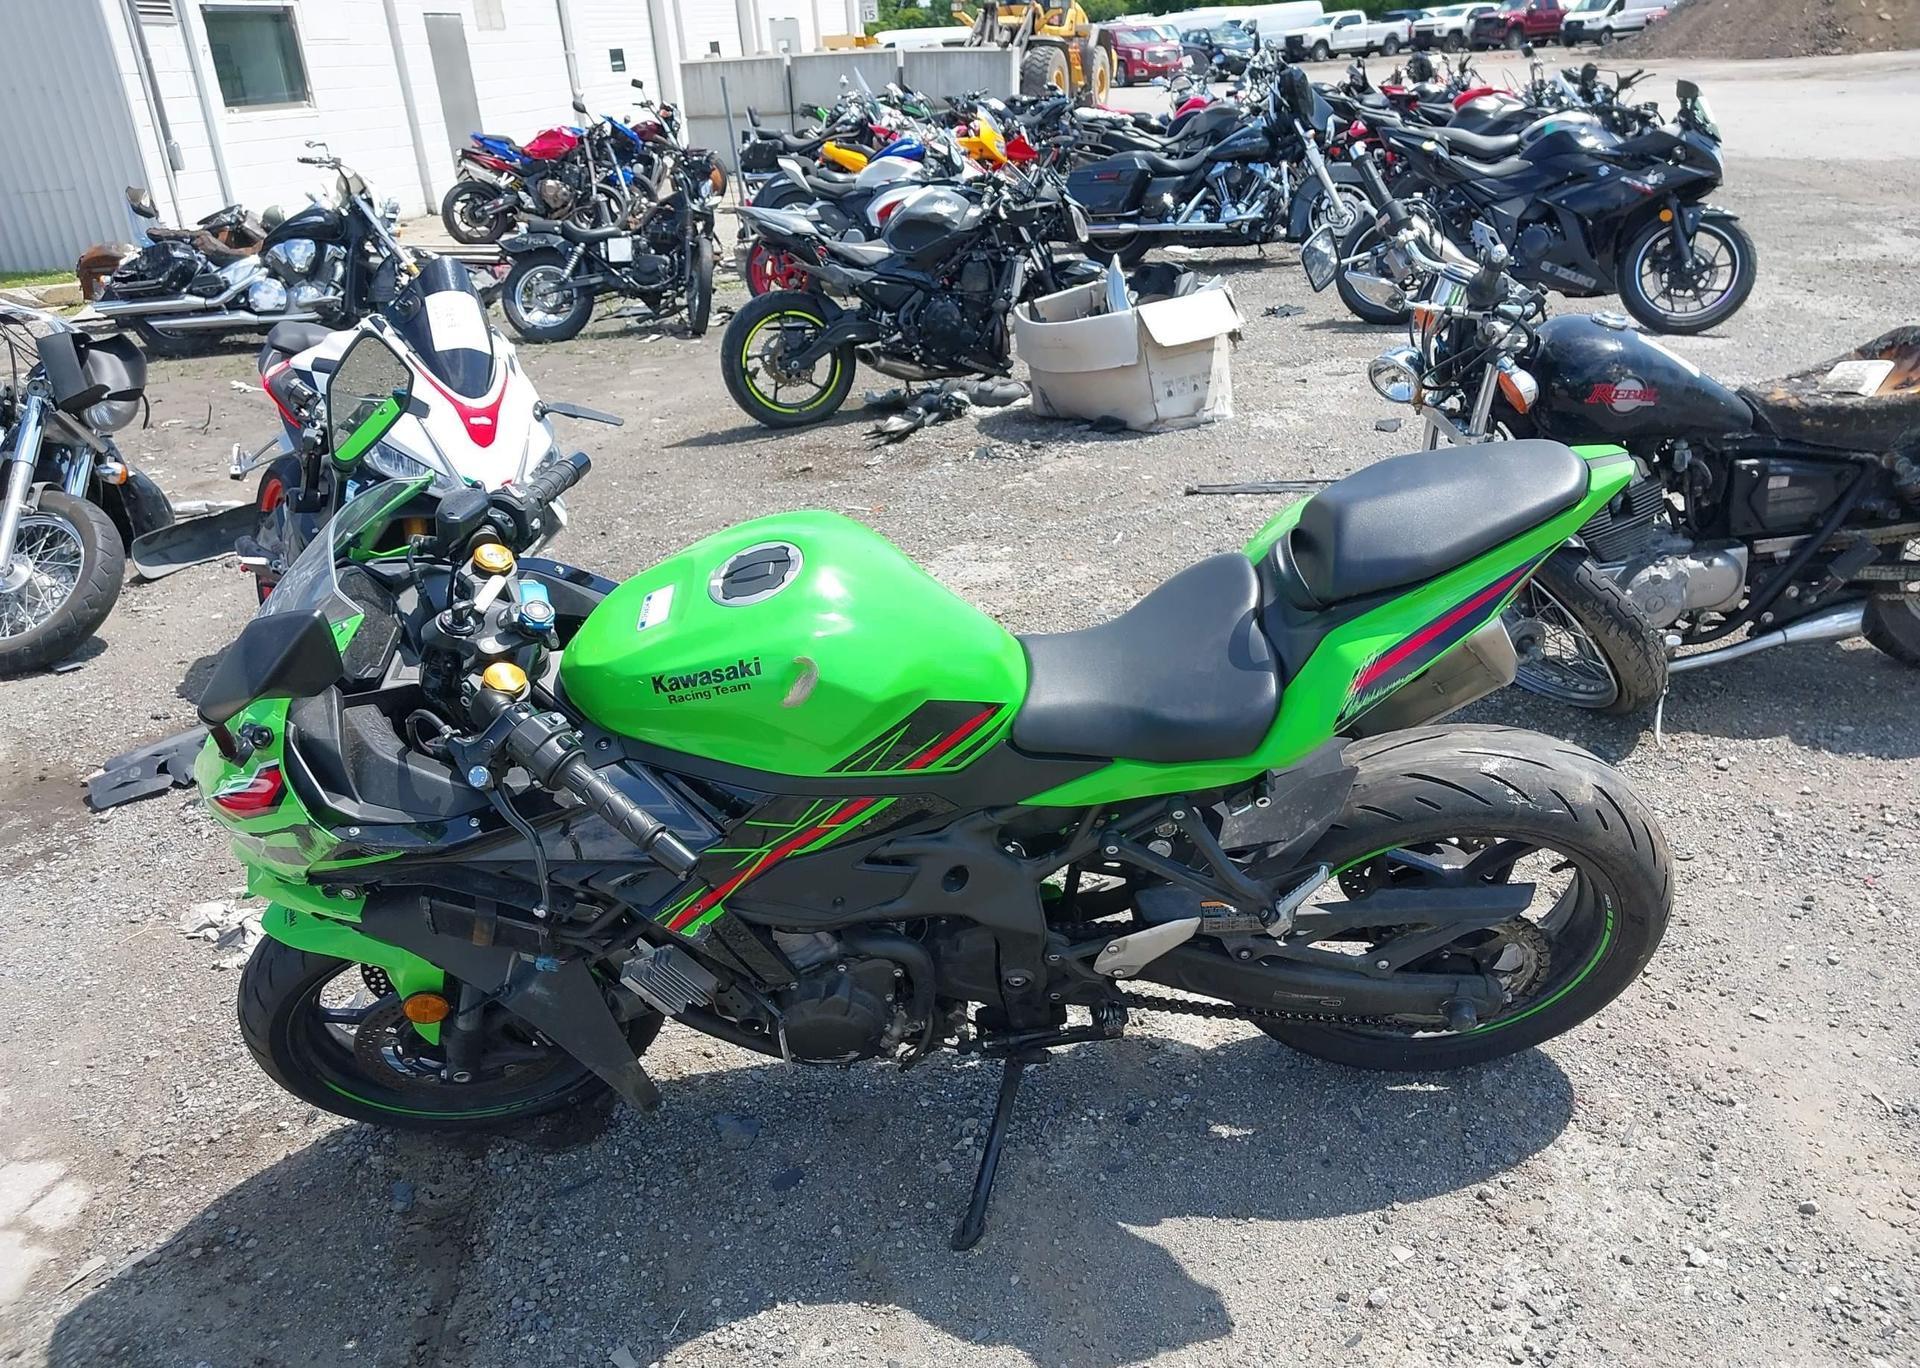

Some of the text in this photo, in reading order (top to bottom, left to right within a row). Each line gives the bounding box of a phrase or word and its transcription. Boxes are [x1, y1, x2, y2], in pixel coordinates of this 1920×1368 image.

[864, 10, 876, 21] 15
[1540, 260, 1597, 289] SZUKI
[651, 656, 762, 695] Kawasaki
[667, 682, 752, 705] Racing Team
